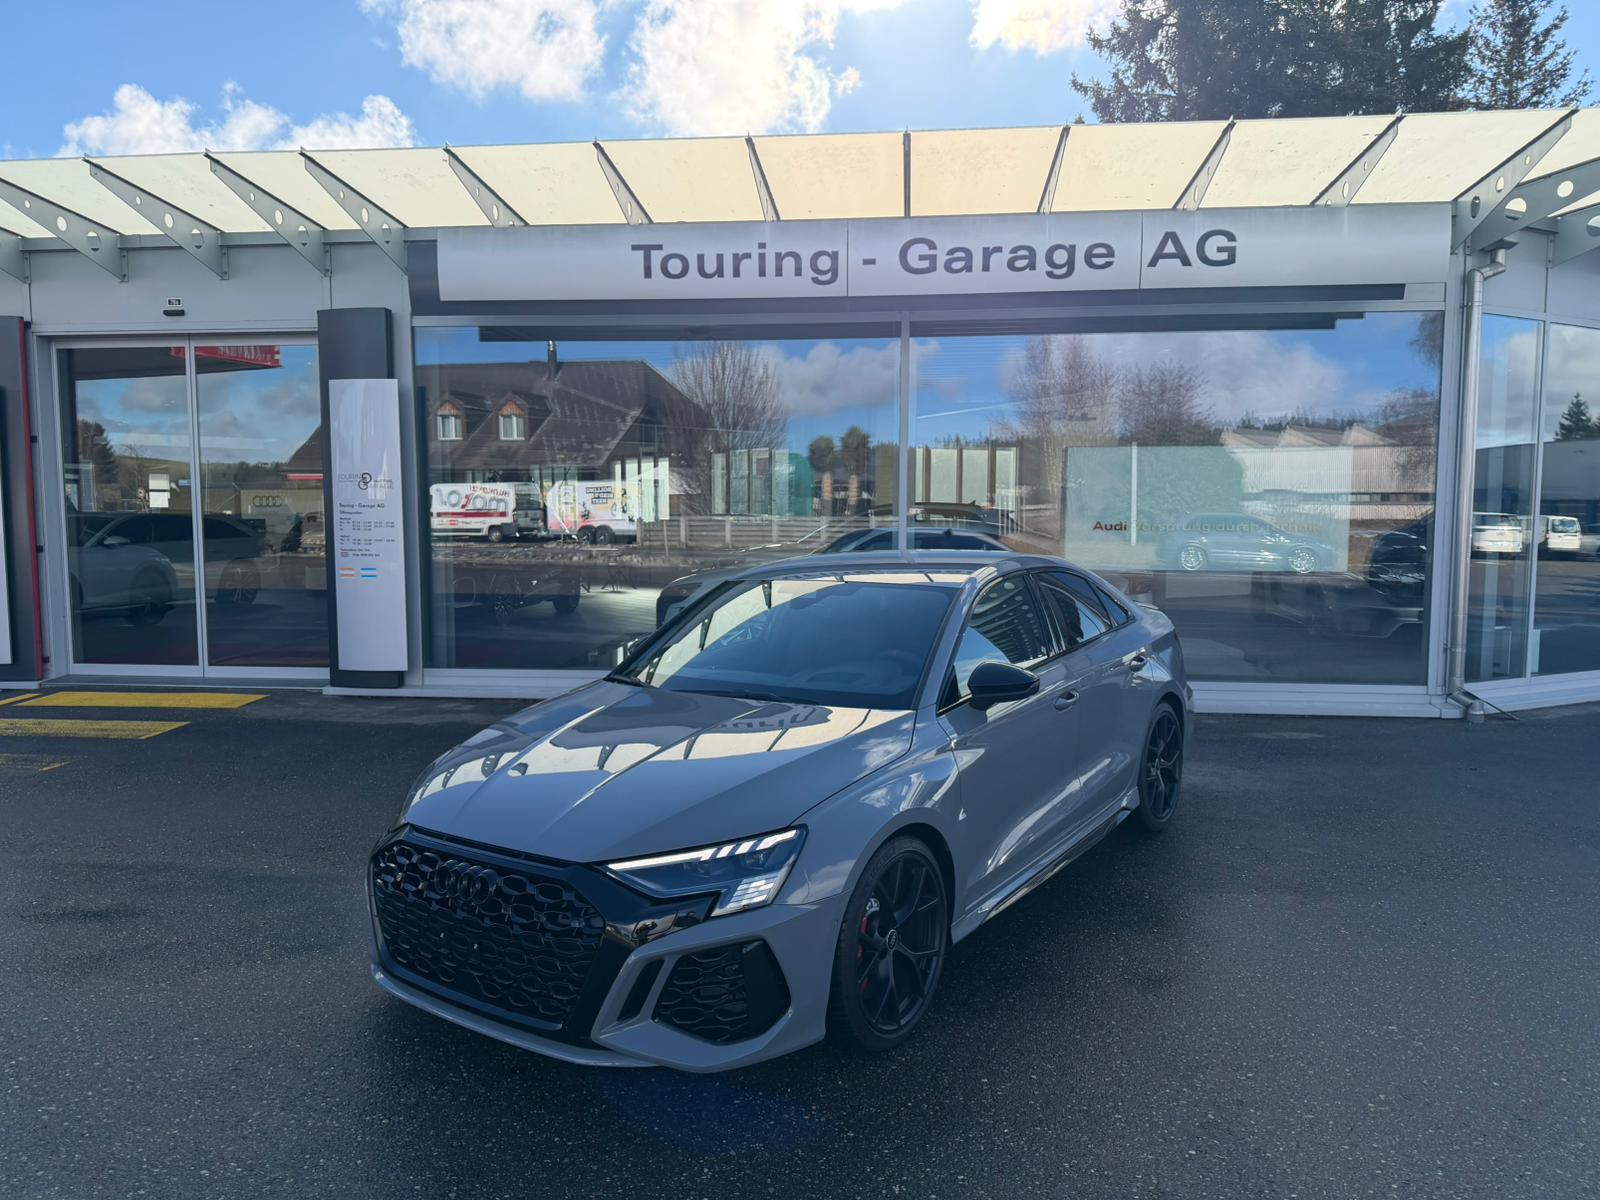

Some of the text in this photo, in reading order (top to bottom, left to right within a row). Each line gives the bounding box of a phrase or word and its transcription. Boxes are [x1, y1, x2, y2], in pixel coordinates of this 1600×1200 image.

[631, 229, 1239, 286] Touring - Garage AG
[1092, 520, 1128, 532] Audi
